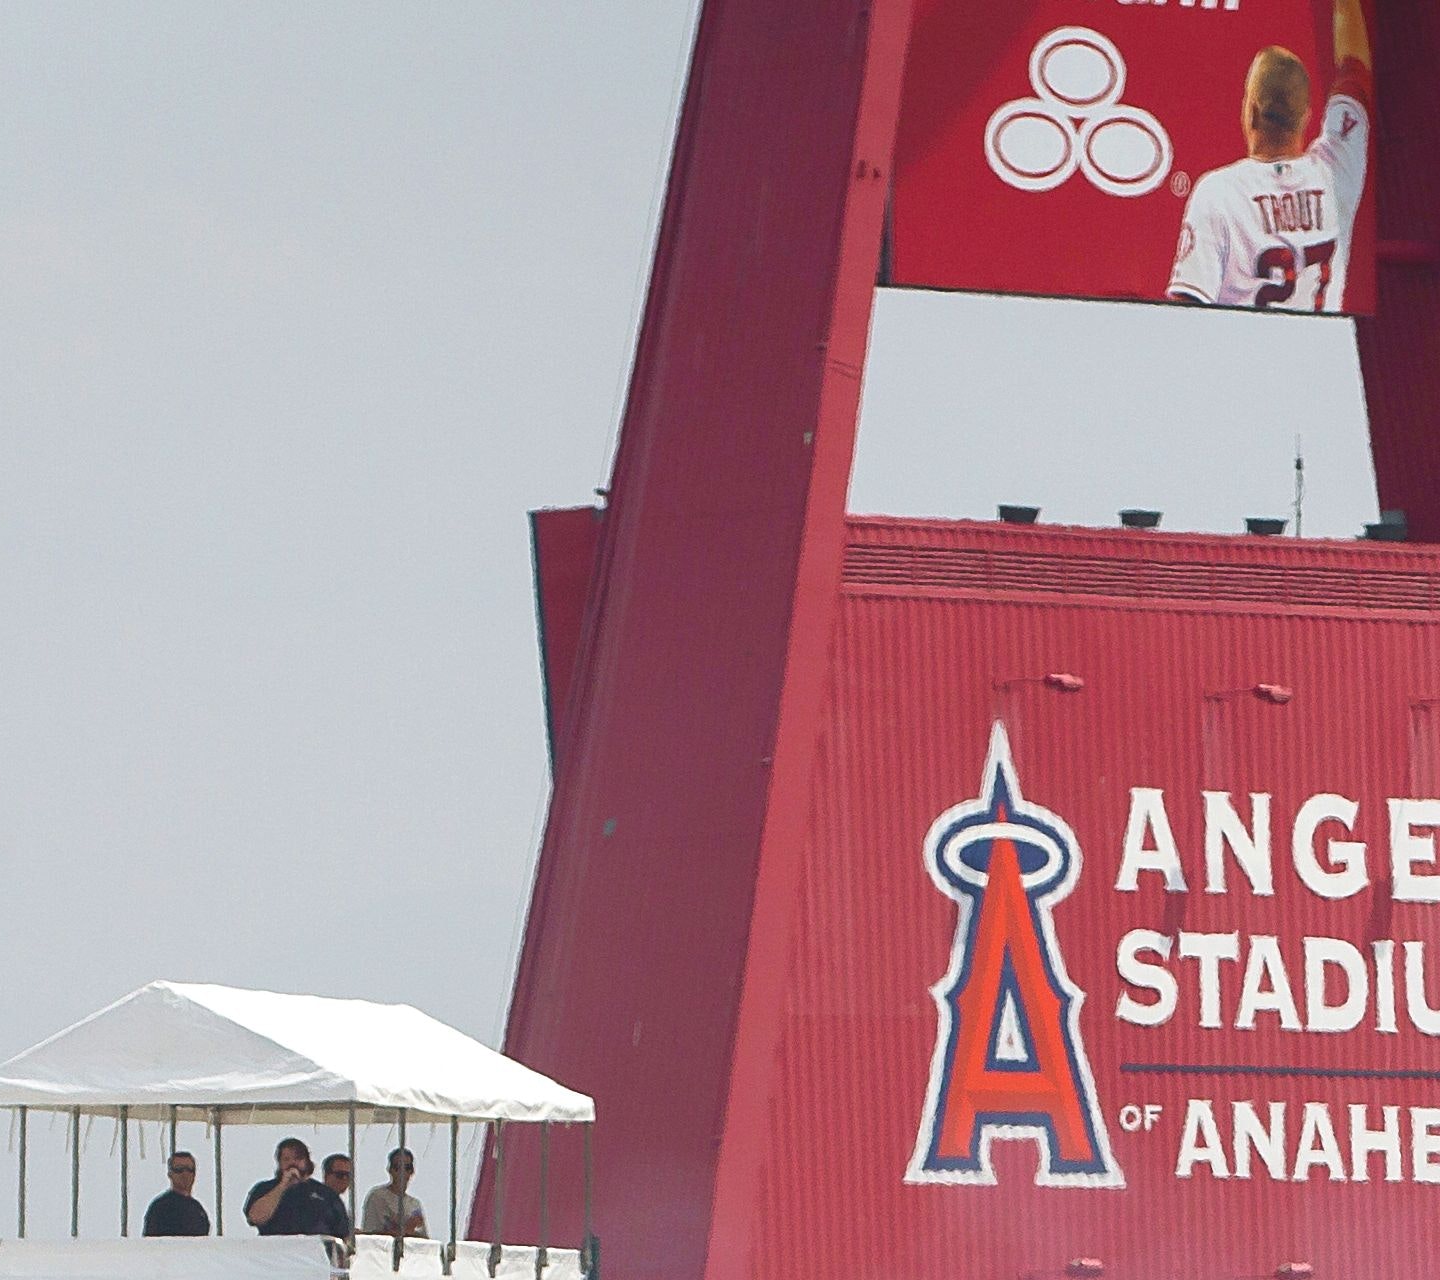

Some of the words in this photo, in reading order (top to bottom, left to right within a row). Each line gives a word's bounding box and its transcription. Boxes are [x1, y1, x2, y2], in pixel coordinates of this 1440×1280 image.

[1253, 190, 1325, 234] TROUT
[1254, 237, 1336, 312] 27
[1120, 1105, 1163, 1133] OF
